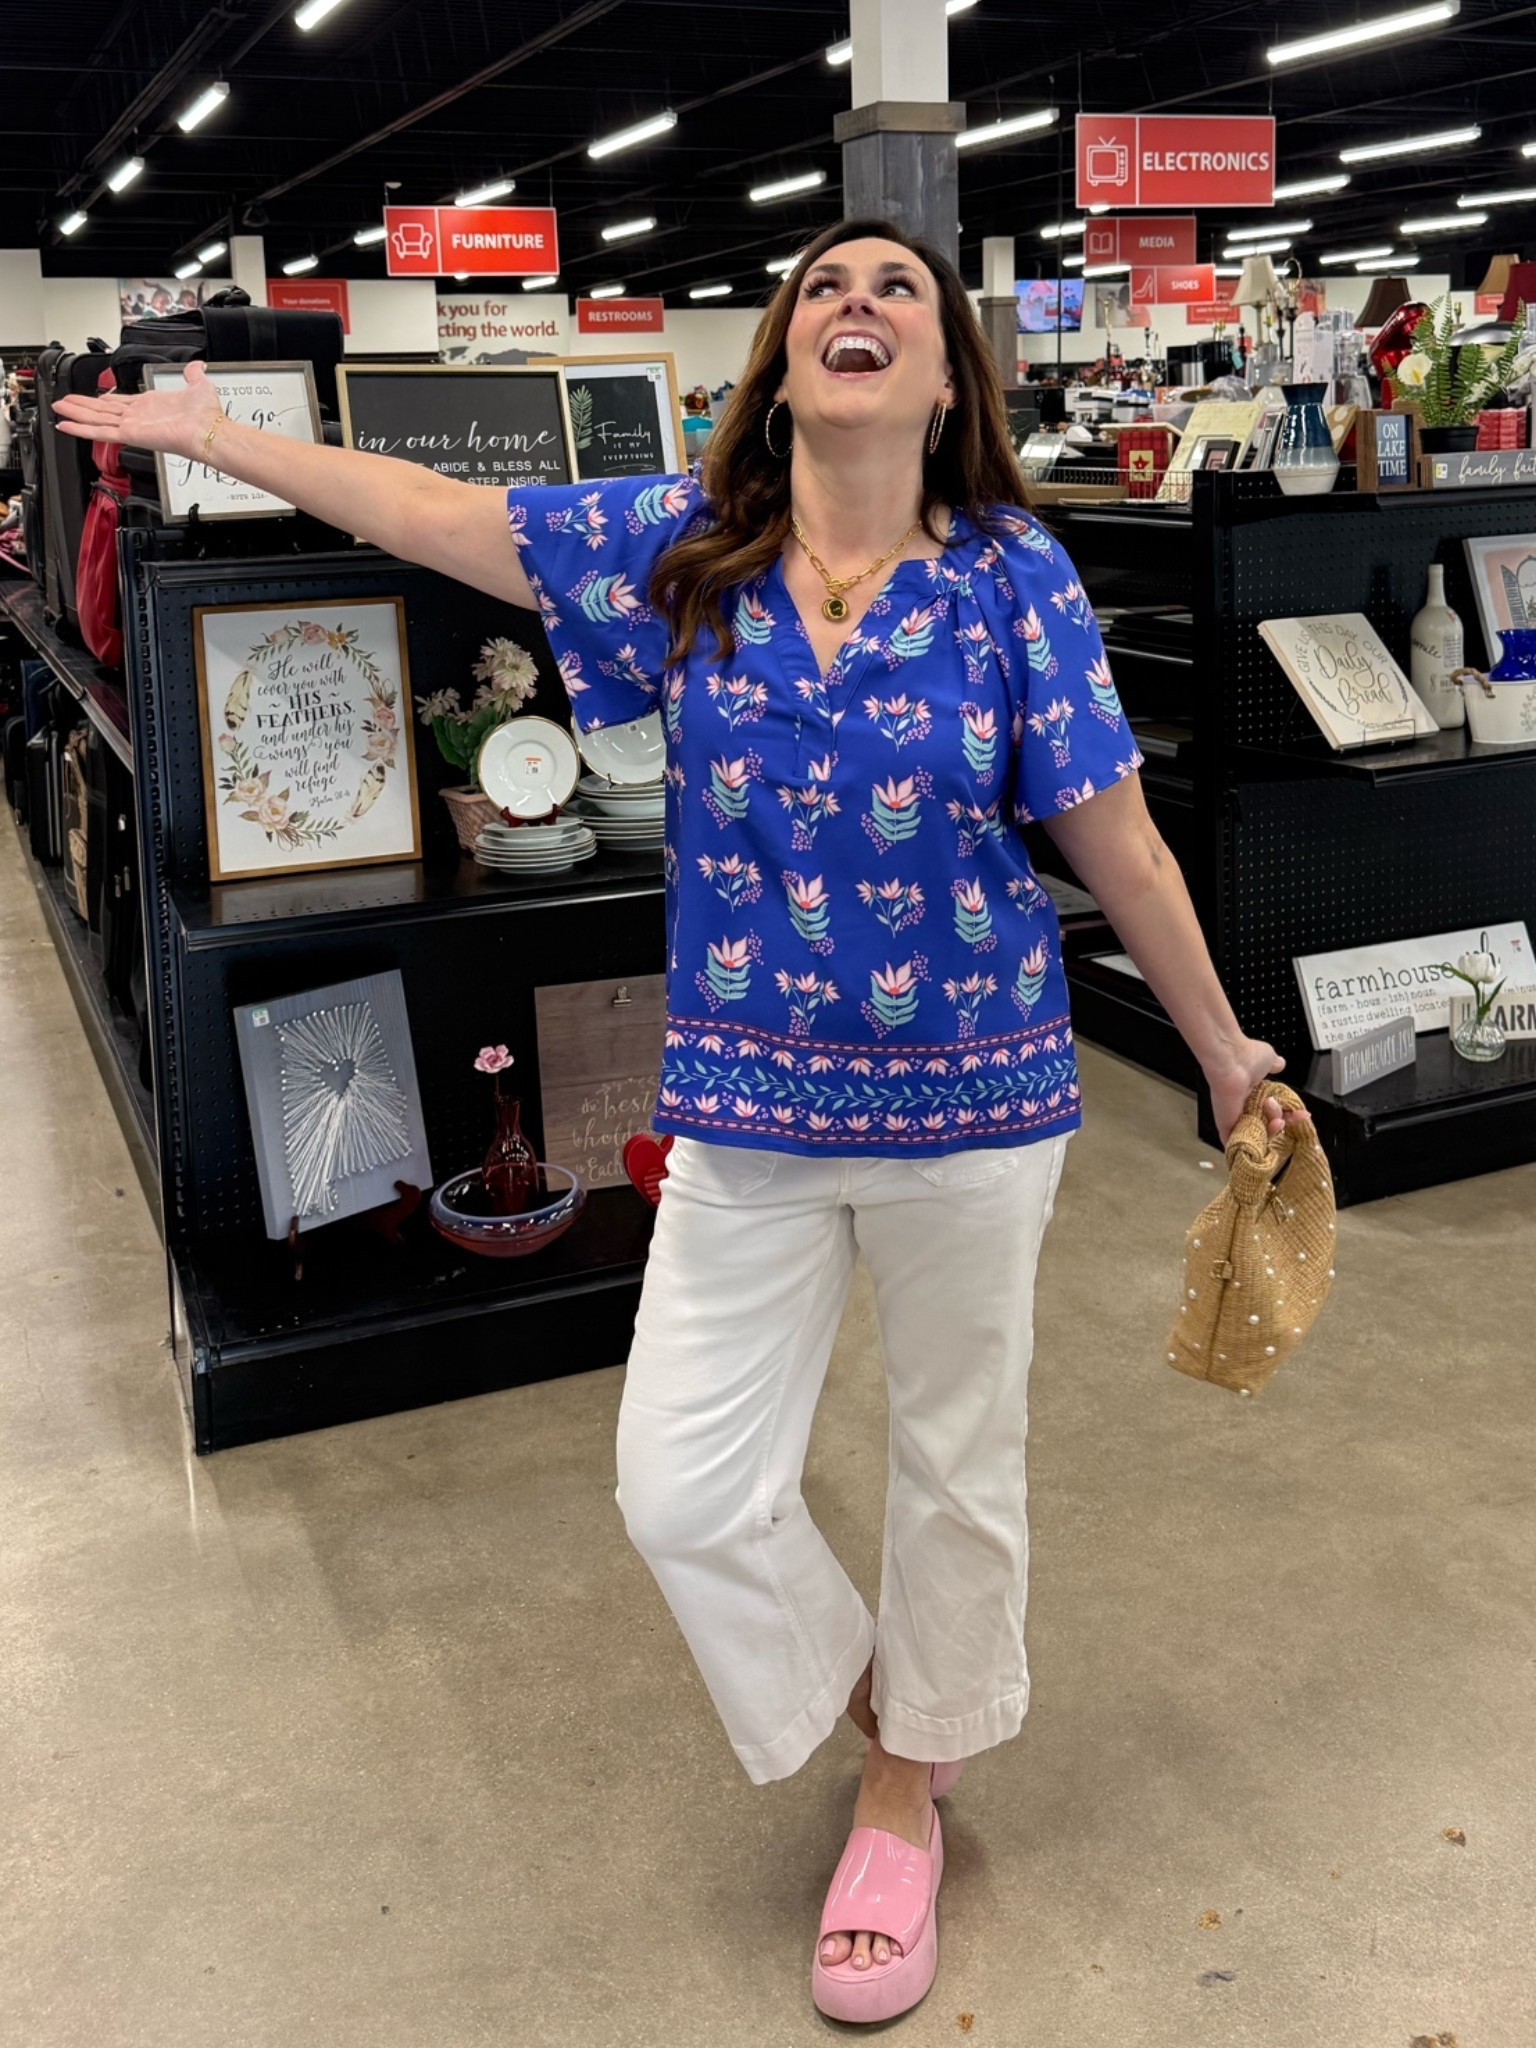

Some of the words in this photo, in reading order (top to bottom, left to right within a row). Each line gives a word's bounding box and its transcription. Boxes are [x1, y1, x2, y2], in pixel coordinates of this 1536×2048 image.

[1142, 151, 1270, 172] ELECTRONICS
[451, 233, 545, 249] FURNITURE
[1138, 236, 1175, 248] MEDIA
[1171, 279, 1200, 290] SHOES
[448, 304, 480, 320] you
[484, 300, 508, 316] for
[588, 311, 653, 322] RESTROOMS
[438, 321, 478, 341] cting
[481, 320, 508, 337] the
[510, 320, 559, 337] world.
[232, 386, 252, 396] YOU
[358, 430, 400, 453] in
[406, 434, 461, 450] our
[467, 420, 557, 453] home
[594, 421, 651, 445] Family
[1382, 423, 1398, 437] ON
[1377, 440, 1406, 457] LAKE
[432, 462, 470, 473] ABIDE
[477, 462, 487, 472] &
[493, 460, 532, 471] BLESS
[539, 459, 561, 471] ALL
[1377, 460, 1407, 476] TIME
[1458, 454, 1506, 485] family
[1513, 452, 1536, 481] fait
[506, 475, 547, 487] INSIDE
[1362, 641, 1388, 663] OUR
[267, 655, 298, 681] He
[302, 653, 334, 673] will
[1314, 640, 1376, 689] Daily
[258, 682, 290, 696] cover
[293, 679, 317, 699] you
[320, 667, 348, 687] with
[289, 690, 322, 709] HIS
[1337, 672, 1393, 715] Bread
[261, 725, 290, 746] and
[291, 720, 332, 743] under
[334, 715, 354, 736] his
[262, 741, 313, 761] wings
[325, 739, 354, 760] you
[285, 759, 310, 779] will
[313, 754, 341, 779] find
[294, 774, 338, 793] refuge
[1331, 1014, 1364, 1028] rustic
[1367, 1006, 1411, 1021] dwelling
[1325, 1032, 1344, 1043] the
